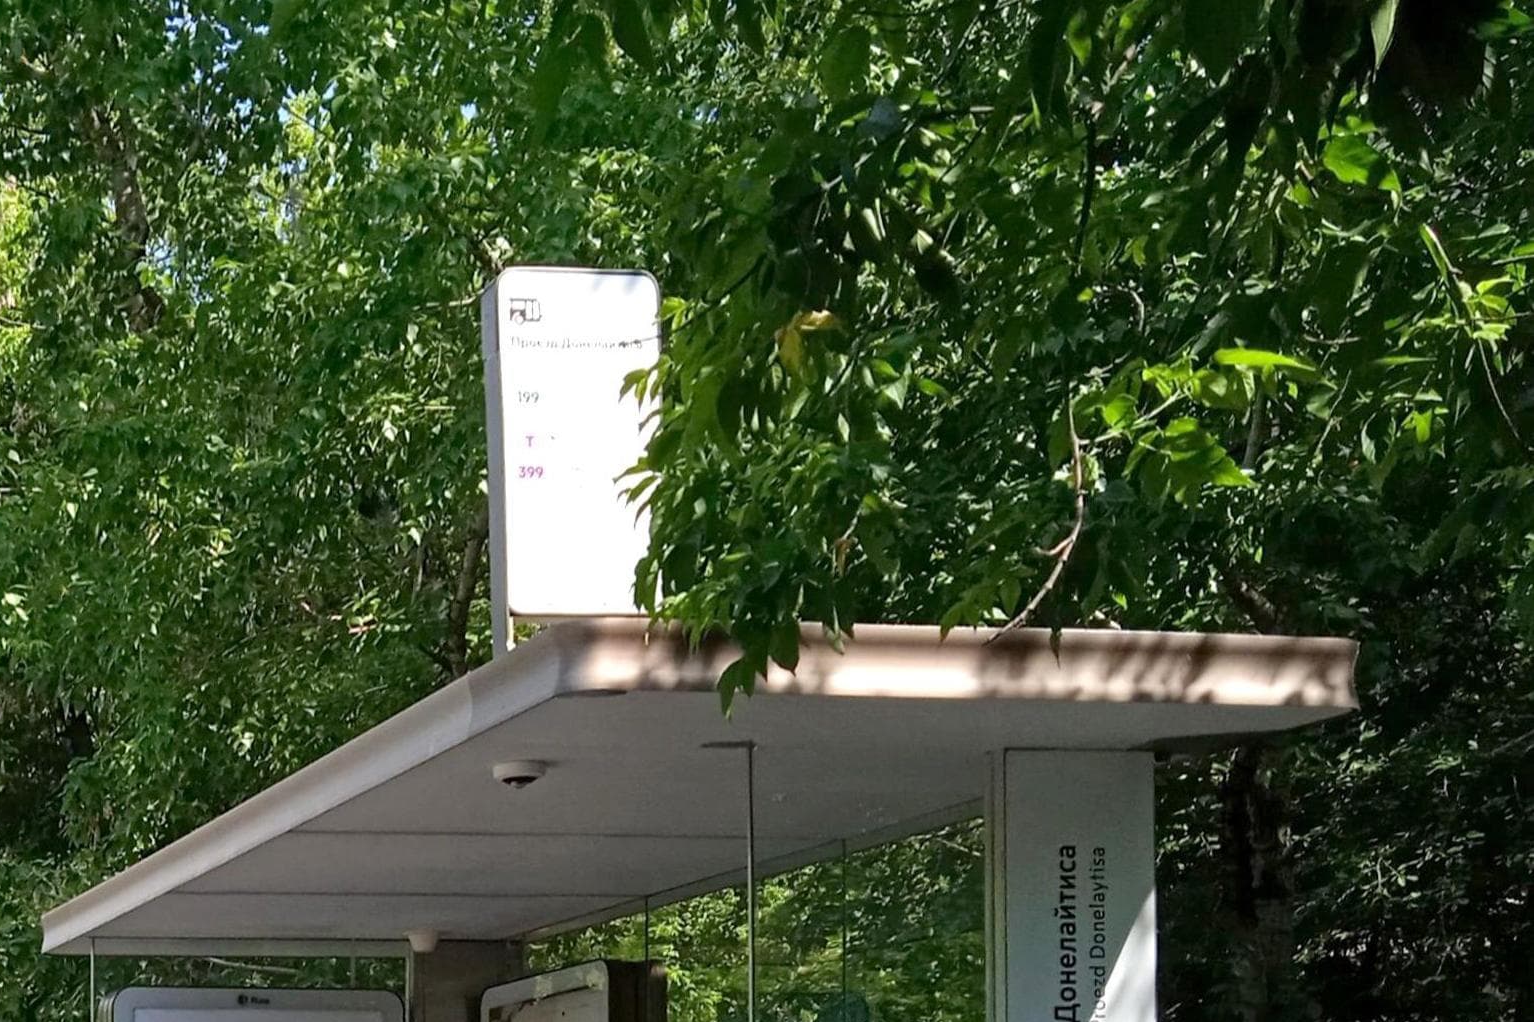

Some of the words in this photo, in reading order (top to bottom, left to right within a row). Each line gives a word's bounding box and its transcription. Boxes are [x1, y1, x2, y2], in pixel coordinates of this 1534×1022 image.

[518, 391, 539, 403] 199
[519, 466, 544, 479] 399
[1089, 847, 1108, 959] Donelaytisa
